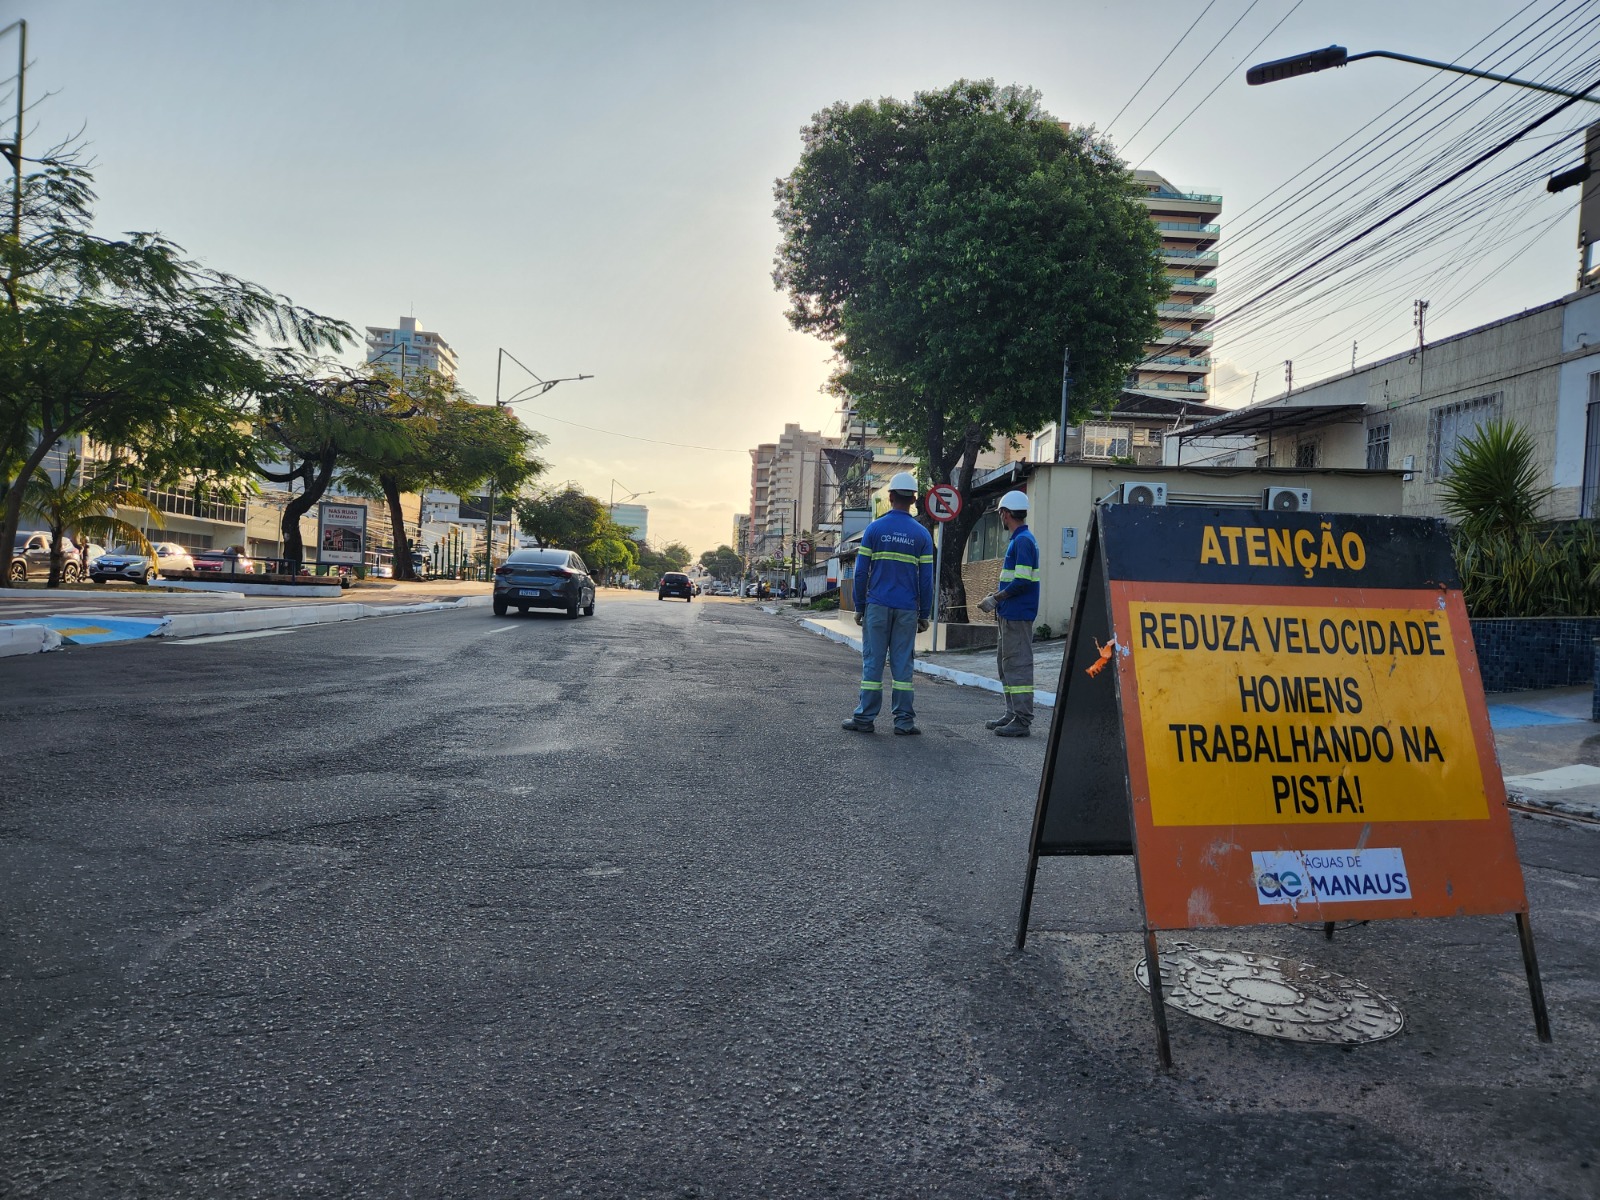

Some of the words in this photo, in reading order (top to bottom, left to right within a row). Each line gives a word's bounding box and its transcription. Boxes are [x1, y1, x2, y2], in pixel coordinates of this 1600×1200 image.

[892, 536, 914, 545] MANAUS
[1200, 522, 1367, 578] ATENÇÃO
[1139, 611, 1259, 652] REDUZA
[1262, 617, 1445, 656] VELOCIDADE
[1238, 675, 1363, 714] HOMENS
[1169, 723, 1394, 763] TRABALHANDO
[1400, 725, 1445, 763] NA
[1271, 775, 1365, 814] PISTA!
[1304, 854, 1344, 869] ÁGUAS
[1347, 856, 1362, 868] DE
[1310, 872, 1407, 896] MANAUS
